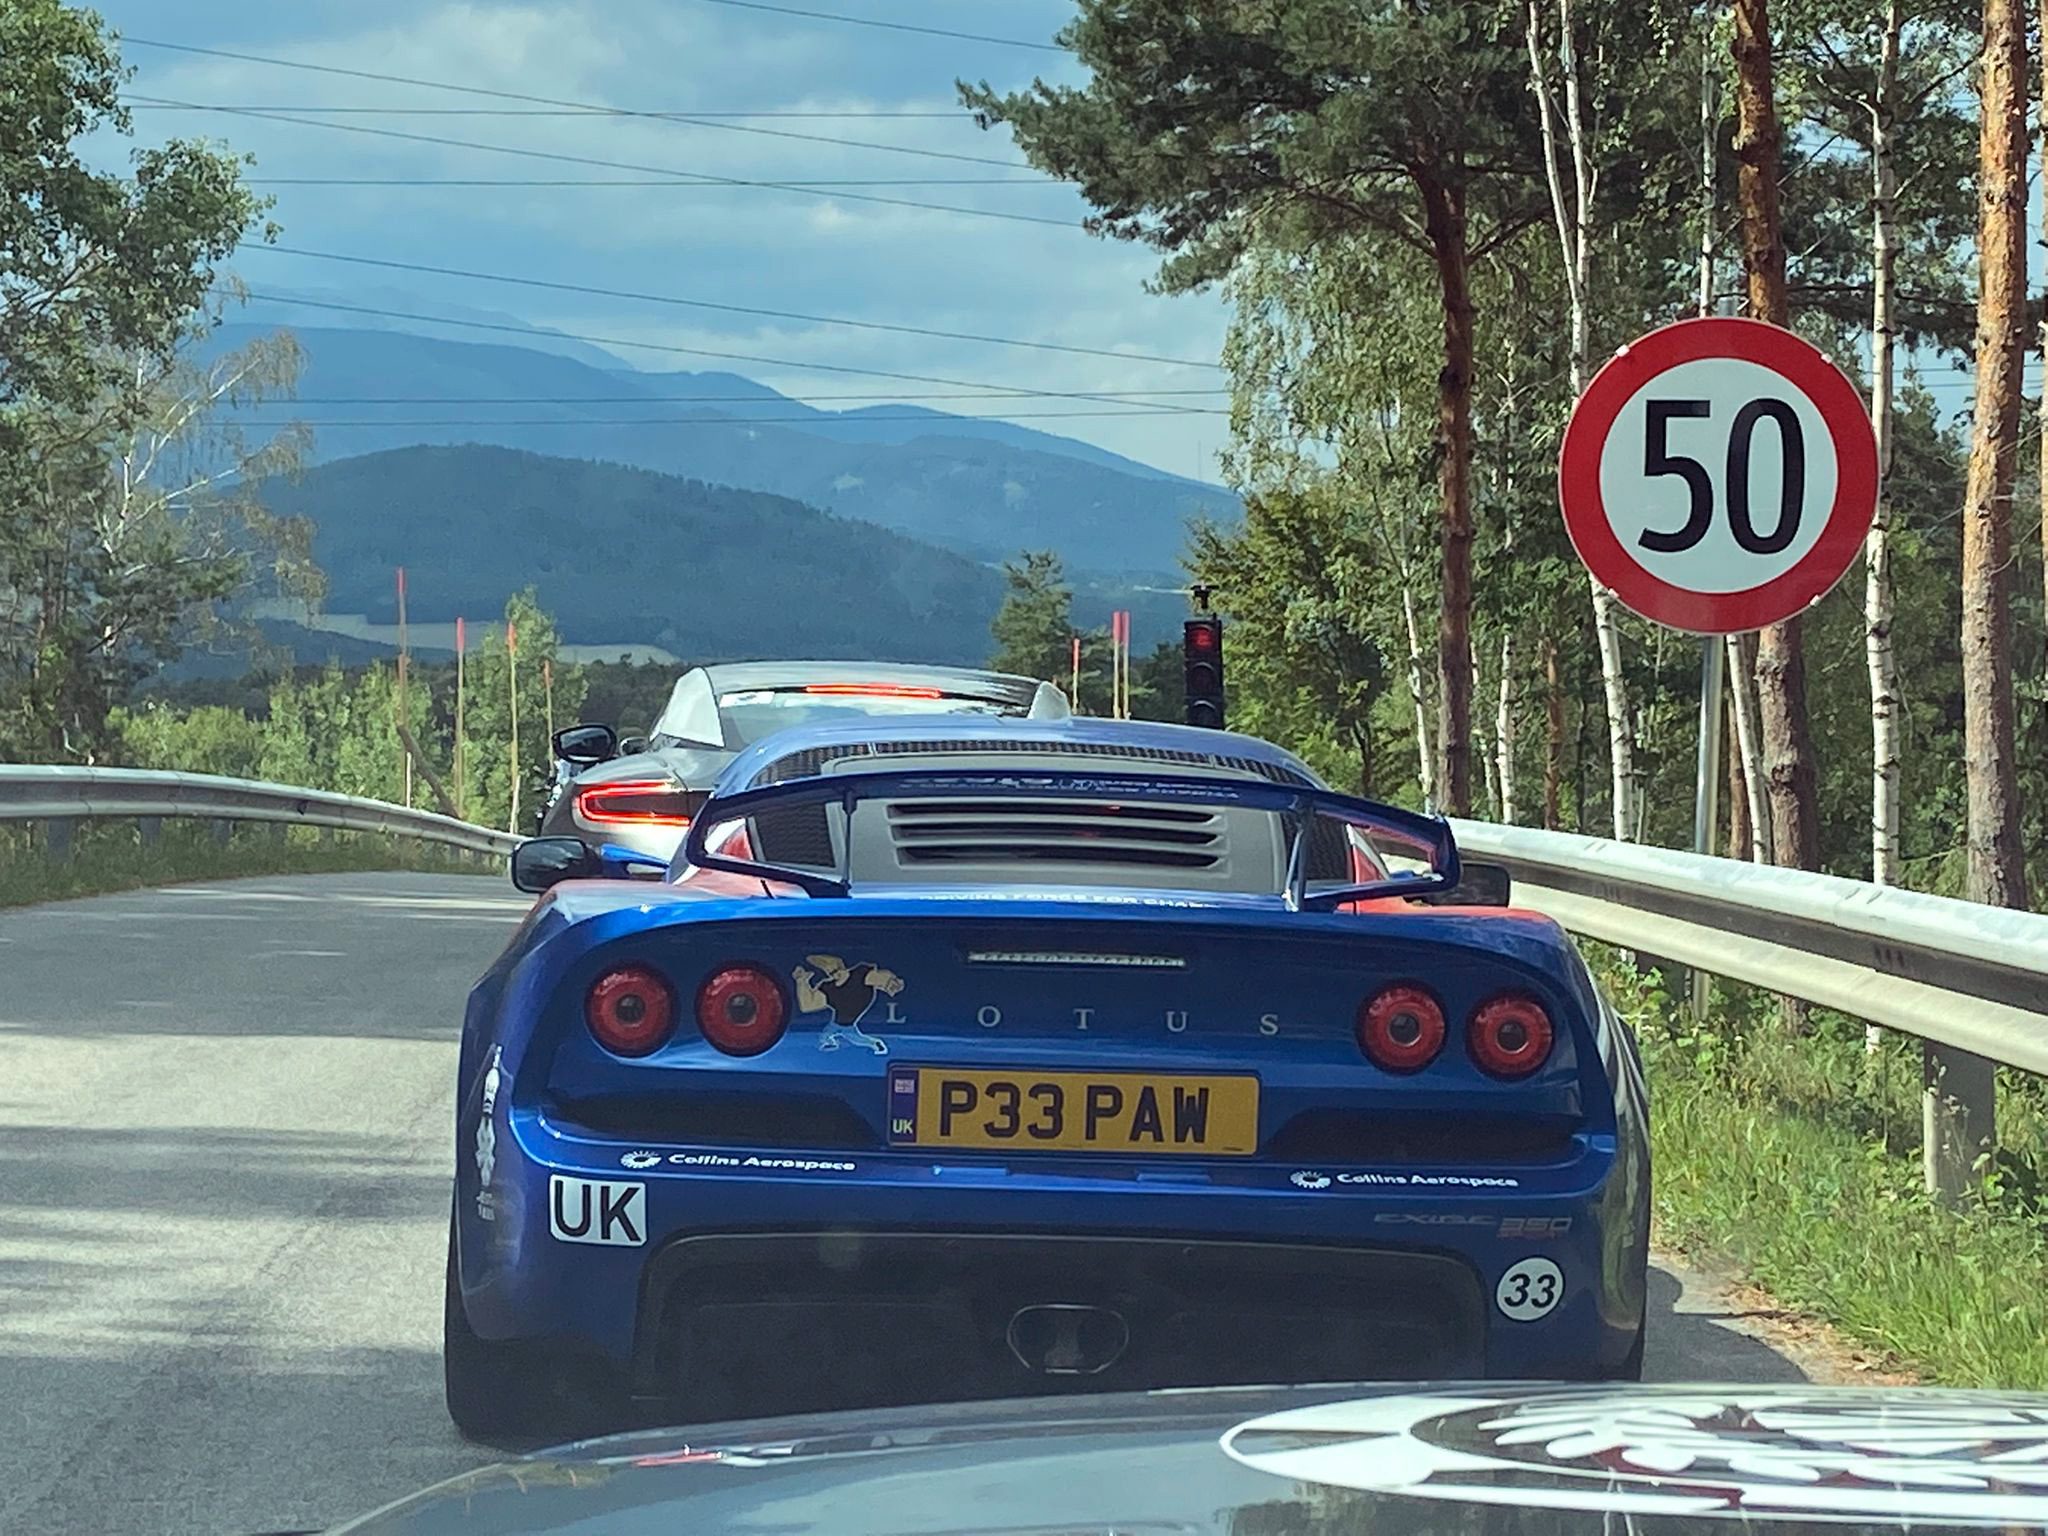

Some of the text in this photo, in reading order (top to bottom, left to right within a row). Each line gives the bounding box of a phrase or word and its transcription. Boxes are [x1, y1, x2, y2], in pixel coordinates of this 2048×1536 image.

[1637, 398, 1805, 554] 50
[886, 1002, 1279, 1035] LOTUS
[892, 1119, 913, 1134] UK
[939, 1080, 1209, 1143] P33 PAW
[668, 1153, 856, 1171] Collins Aerospace
[1337, 1173, 1519, 1187] Collins Aerospace
[554, 1179, 642, 1242] UK
[1503, 1273, 1557, 1309] 33
